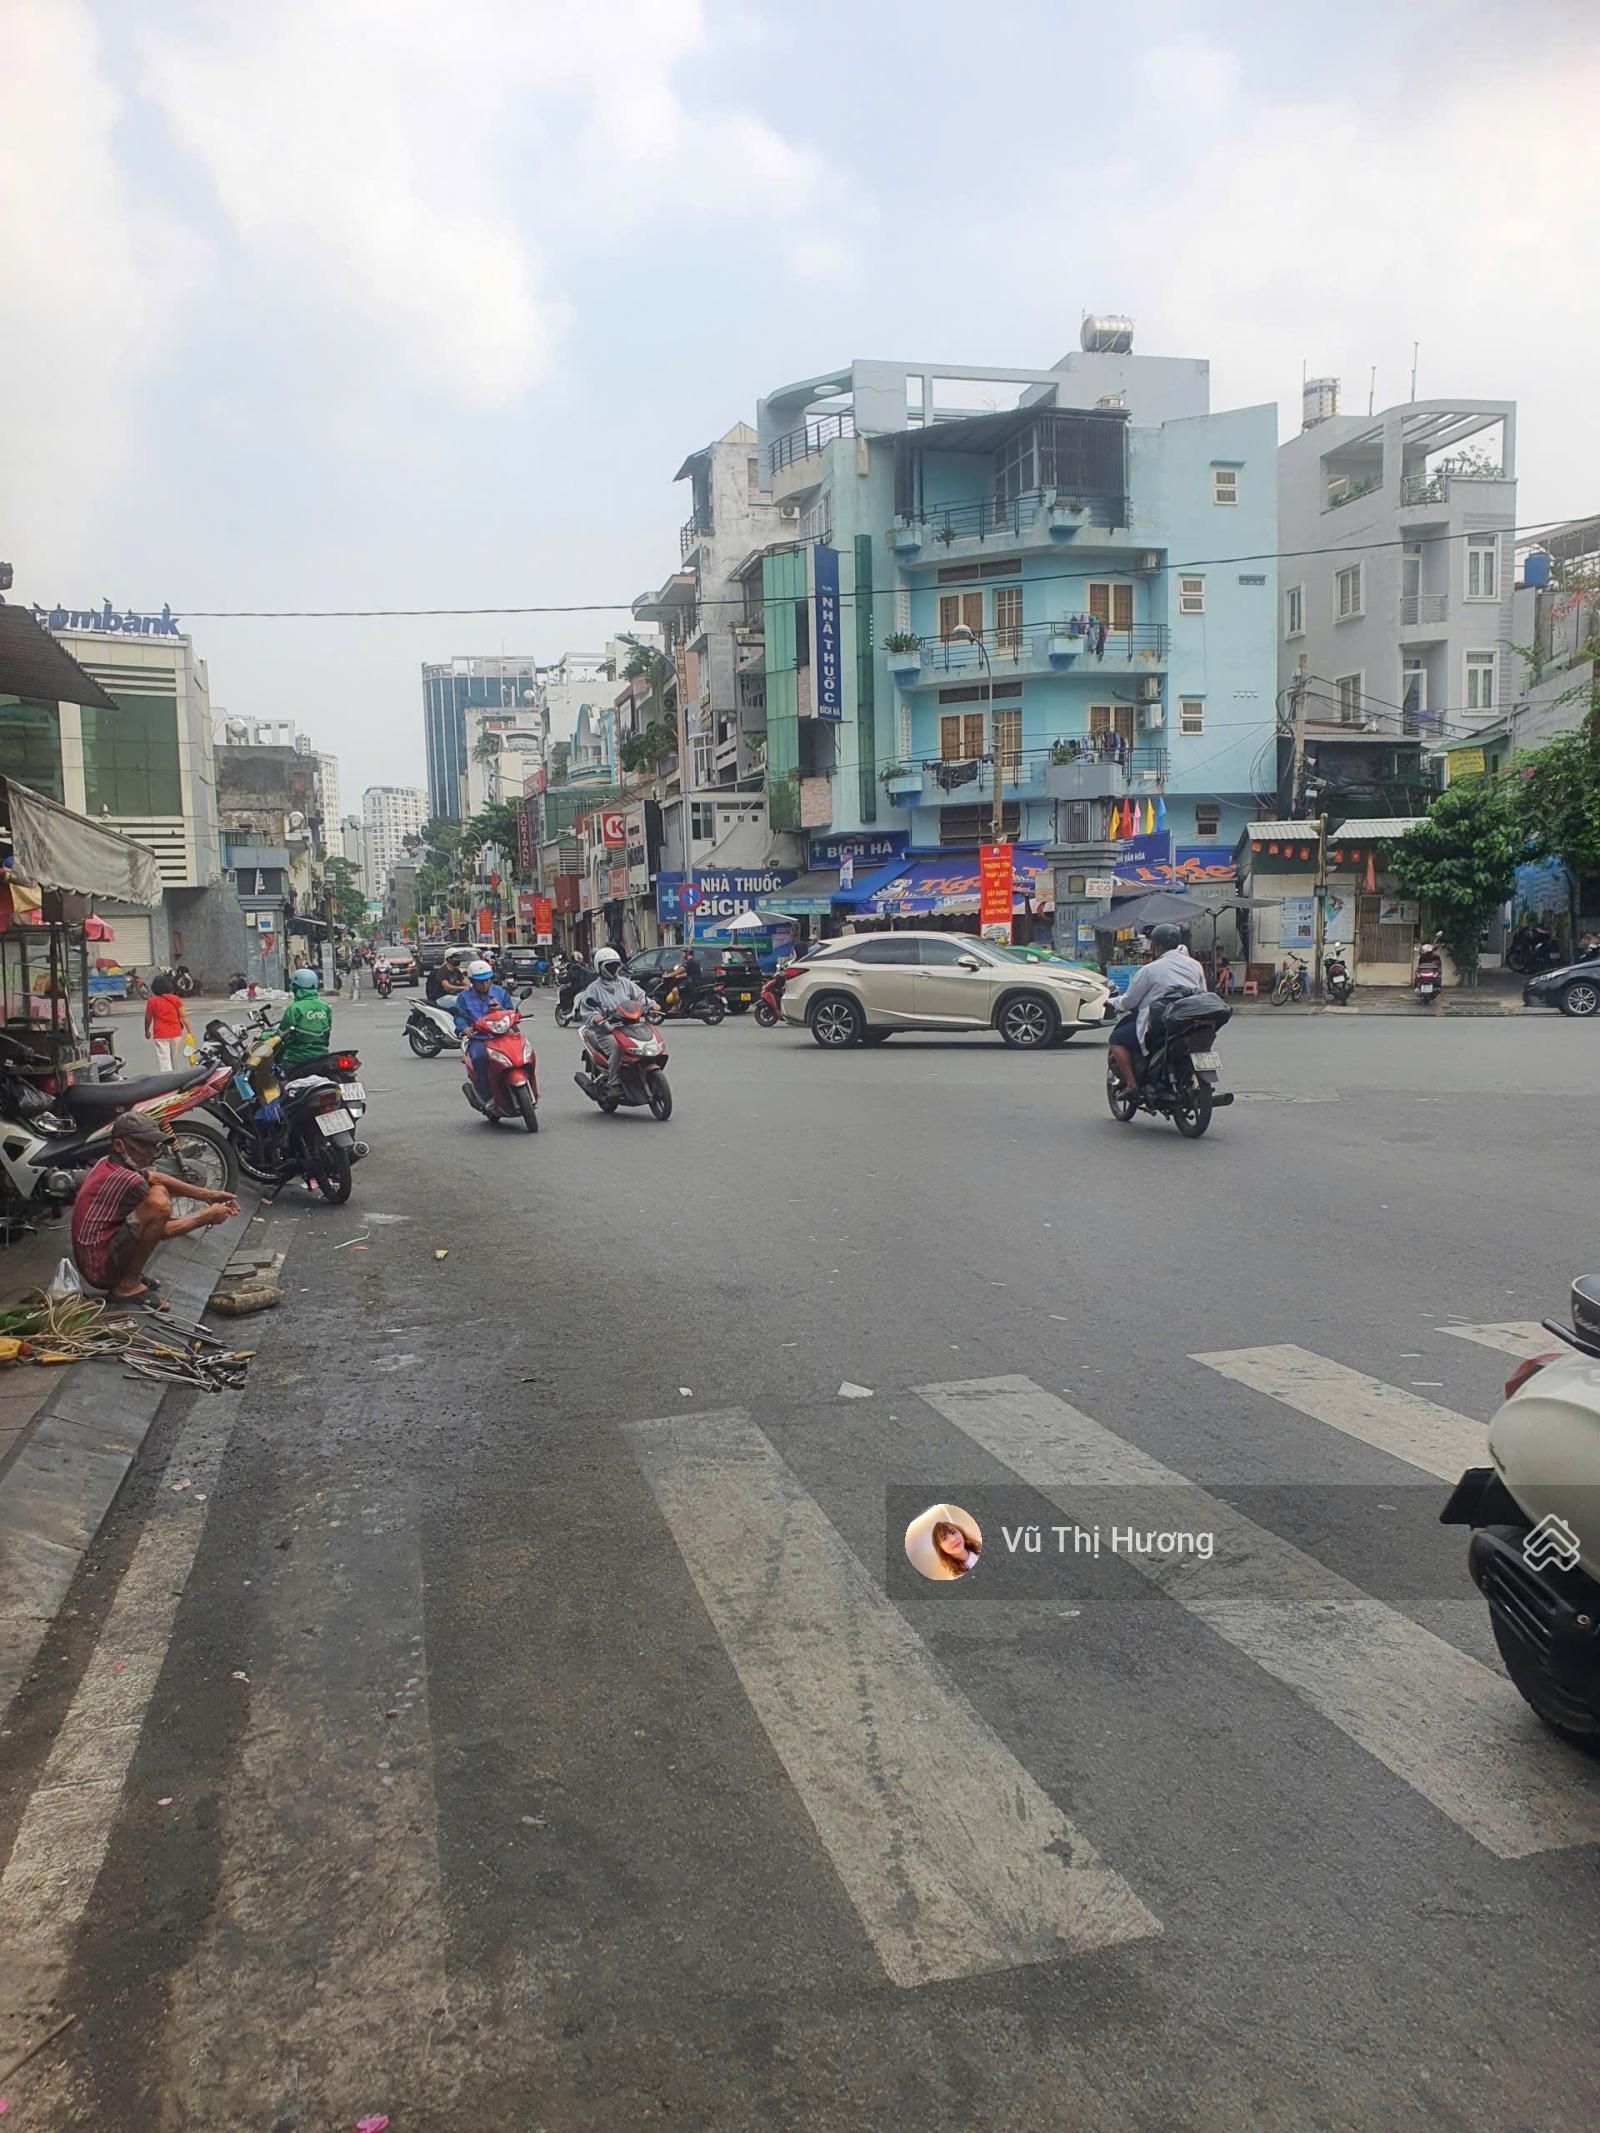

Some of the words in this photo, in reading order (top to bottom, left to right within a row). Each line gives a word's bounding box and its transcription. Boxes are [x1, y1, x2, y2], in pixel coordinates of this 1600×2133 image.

[822, 596, 834, 635] NHÀ
[823, 639, 836, 703] THUỐC
[870, 839, 893, 854] HÀ
[700, 873, 730, 892] NHÀ
[735, 872, 782, 892] THUỐC
[695, 896, 749, 917] BÍCH
